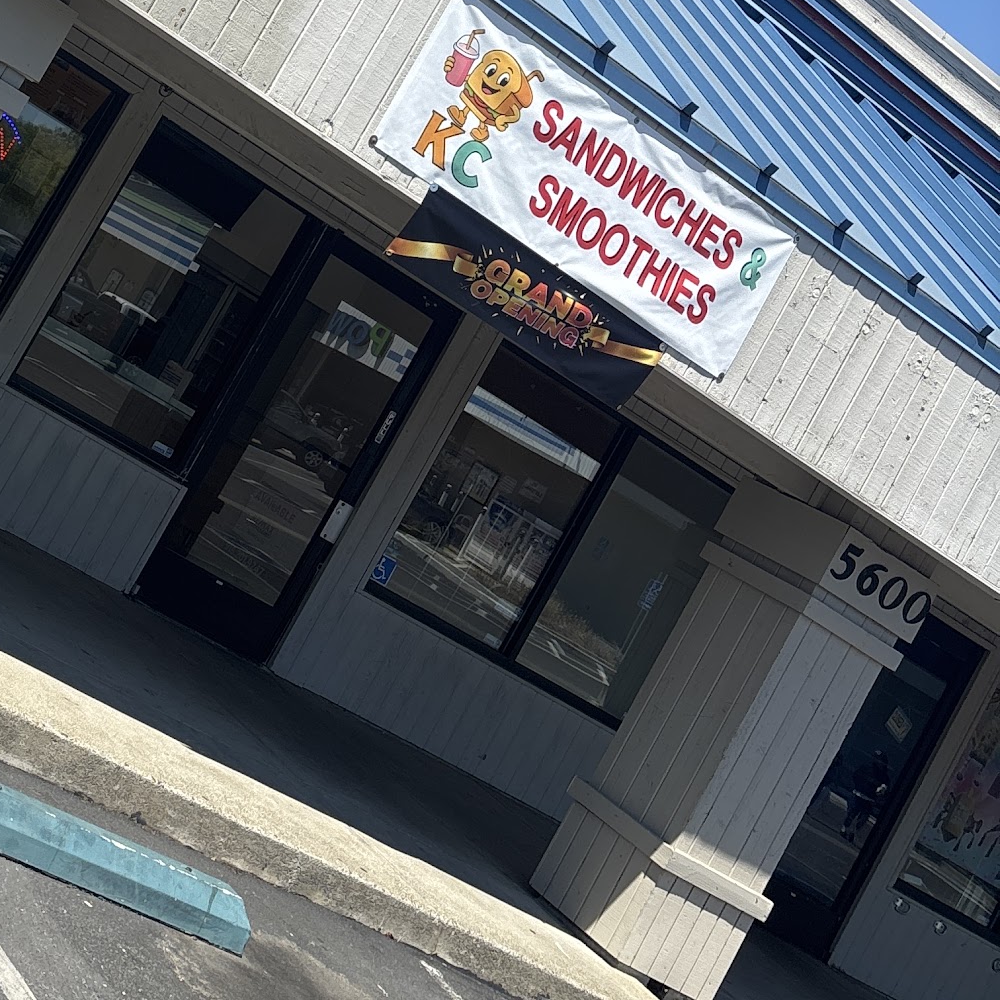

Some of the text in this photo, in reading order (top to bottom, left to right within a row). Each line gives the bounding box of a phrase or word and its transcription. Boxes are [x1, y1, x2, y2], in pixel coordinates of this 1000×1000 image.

[412, 110, 492, 188] KC
[533, 100, 766, 291] SANDWICHES &
[529, 174, 717, 324] SMOOTHIES
[470, 279, 580, 348] OPENING
[485, 259, 593, 328] GRAND
[830, 543, 932, 624] 5600
